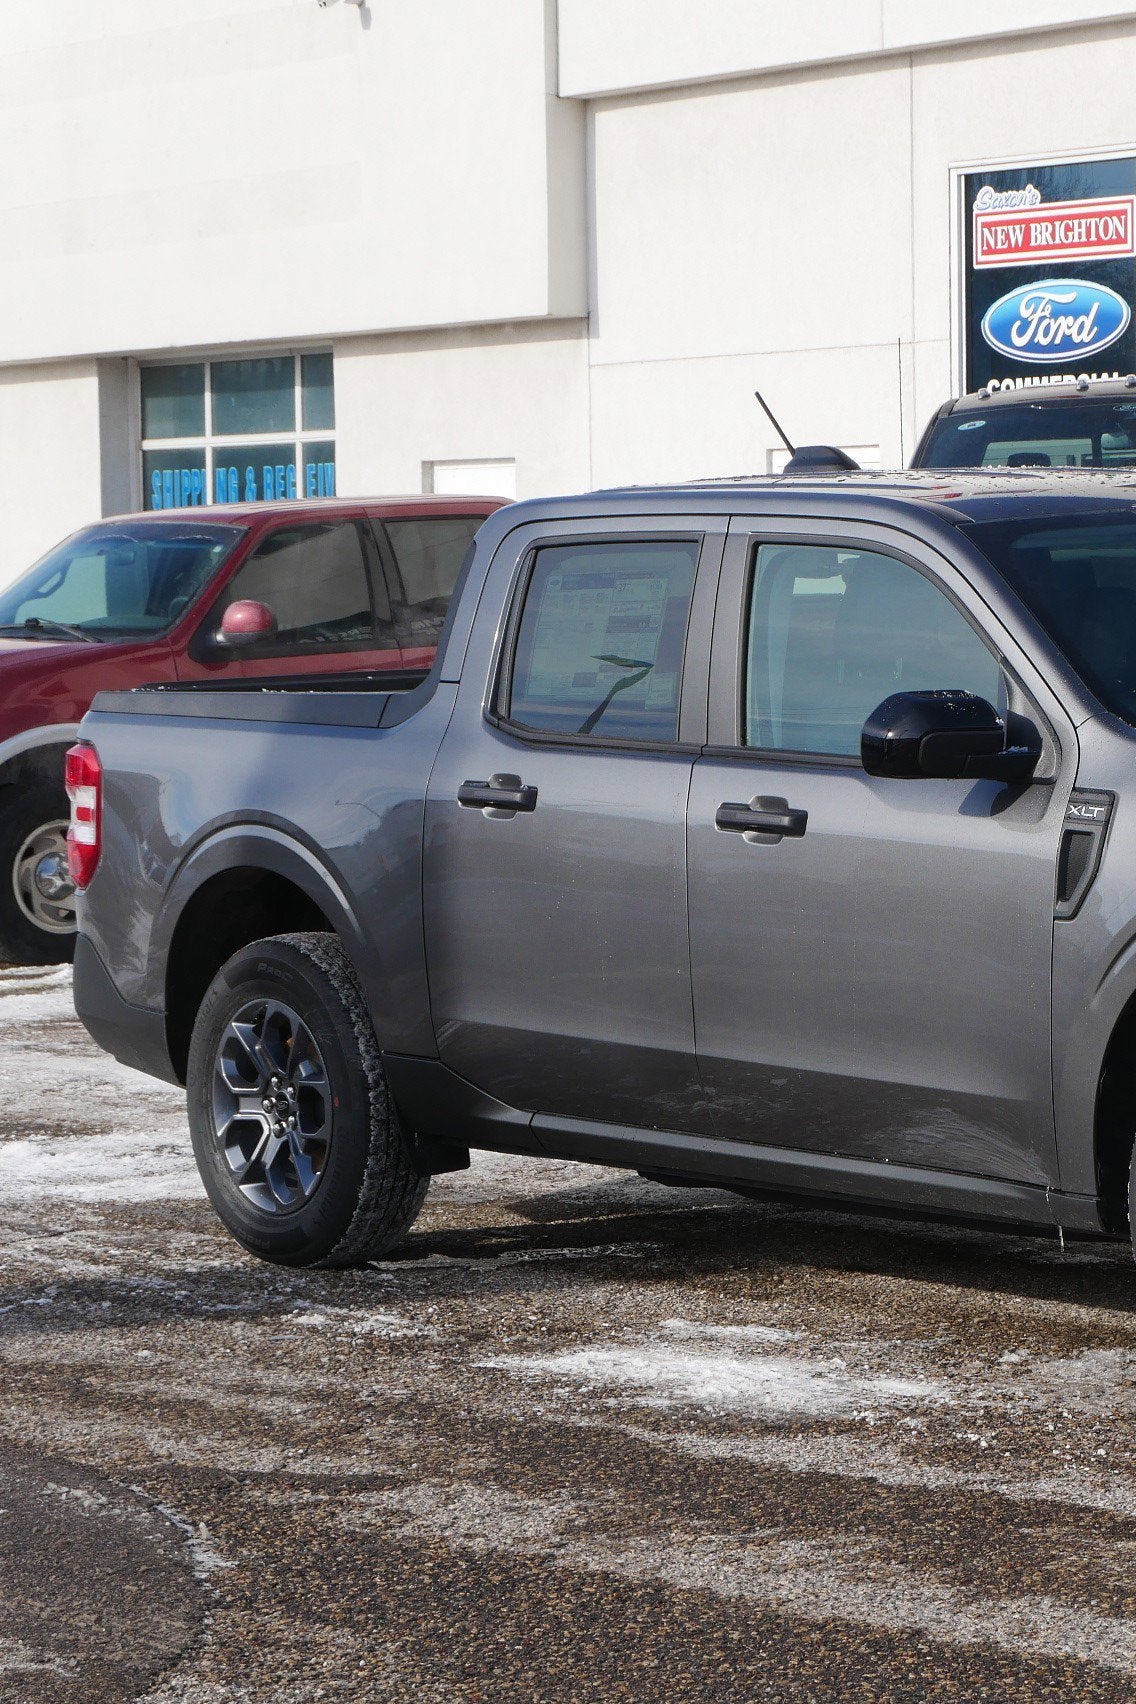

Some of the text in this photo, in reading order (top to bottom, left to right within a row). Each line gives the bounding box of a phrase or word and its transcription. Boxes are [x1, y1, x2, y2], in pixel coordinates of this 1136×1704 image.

[975, 186, 1040, 211] Saxon's
[982, 215, 1127, 251] NEW BRIGHTON
[1010, 291, 1100, 347] Ford
[1066, 804, 1105, 818] XLT
